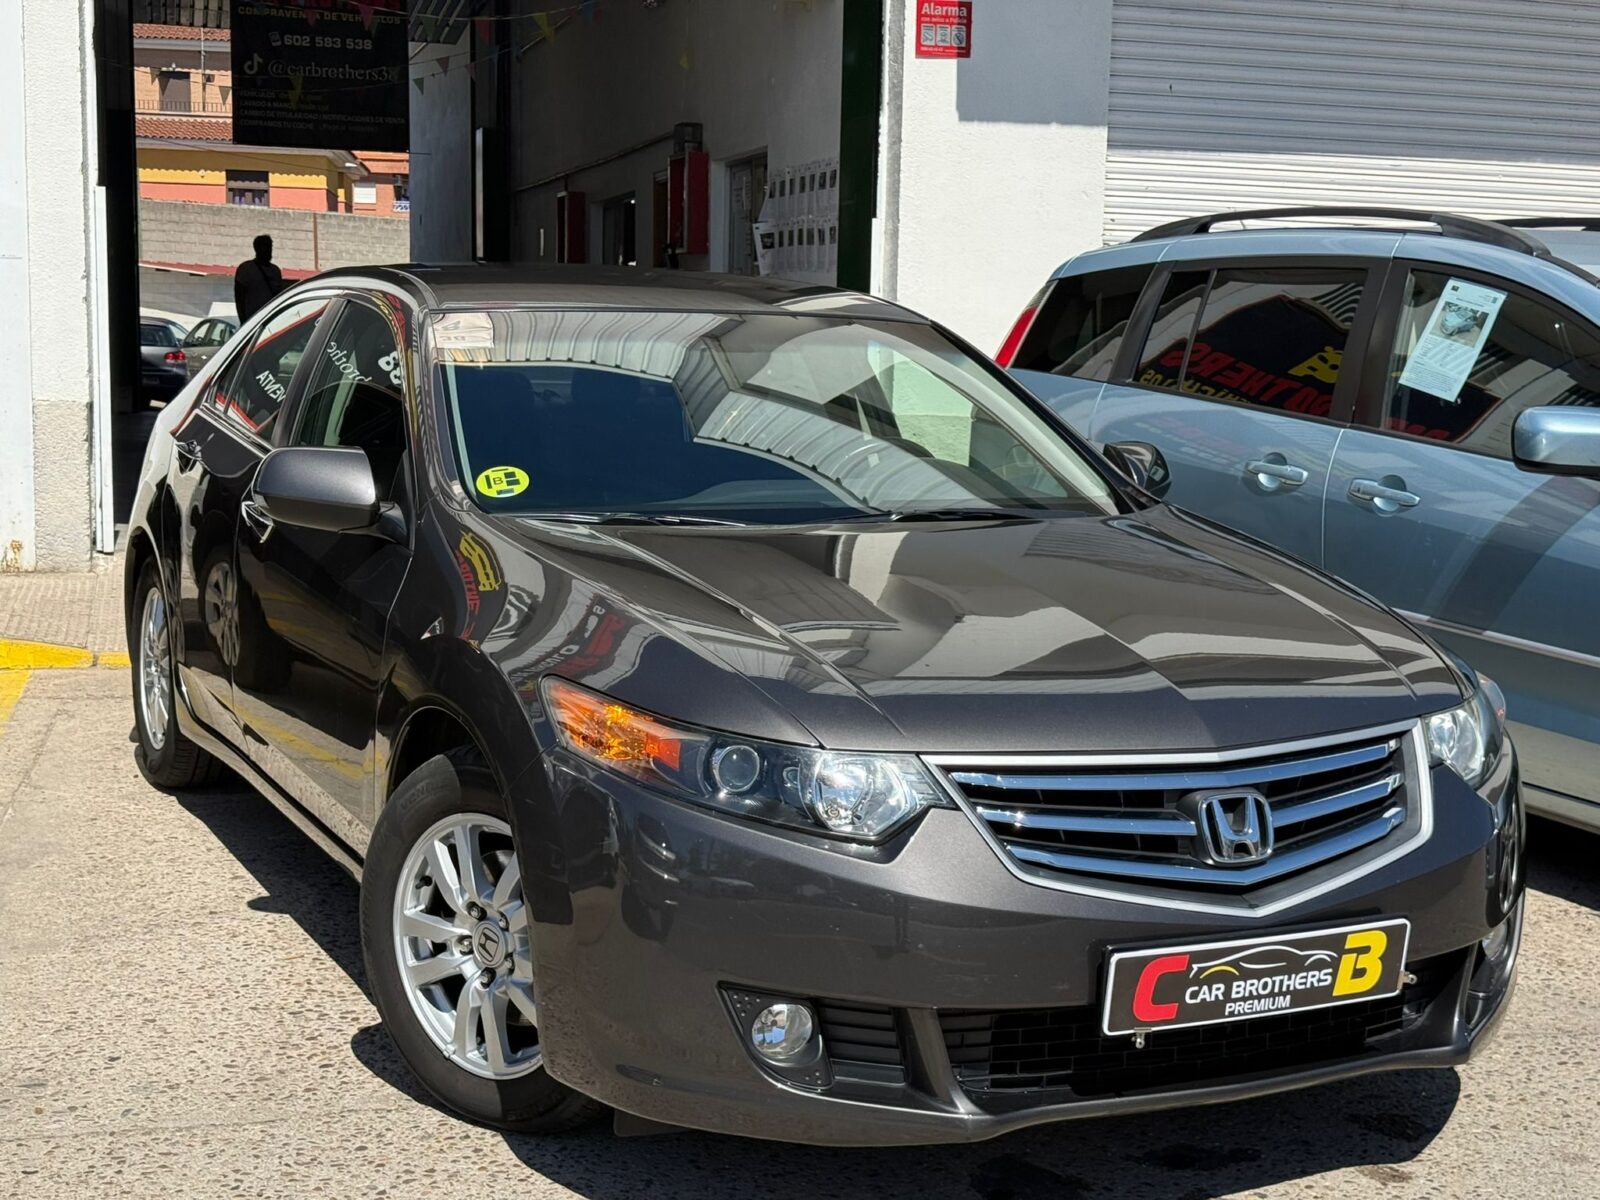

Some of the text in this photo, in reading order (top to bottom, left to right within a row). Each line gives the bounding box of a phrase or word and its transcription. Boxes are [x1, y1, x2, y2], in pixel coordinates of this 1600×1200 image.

[324, 12, 338, 21] DE
[921, 3, 967, 16] Alarma
[284, 35, 373, 50] 602 583 538
[1332, 929, 1388, 997] B
[1132, 954, 1190, 1022] C
[1185, 968, 1333, 1004] CAR BROTHERS
[1224, 994, 1291, 1016] PREMIUM
